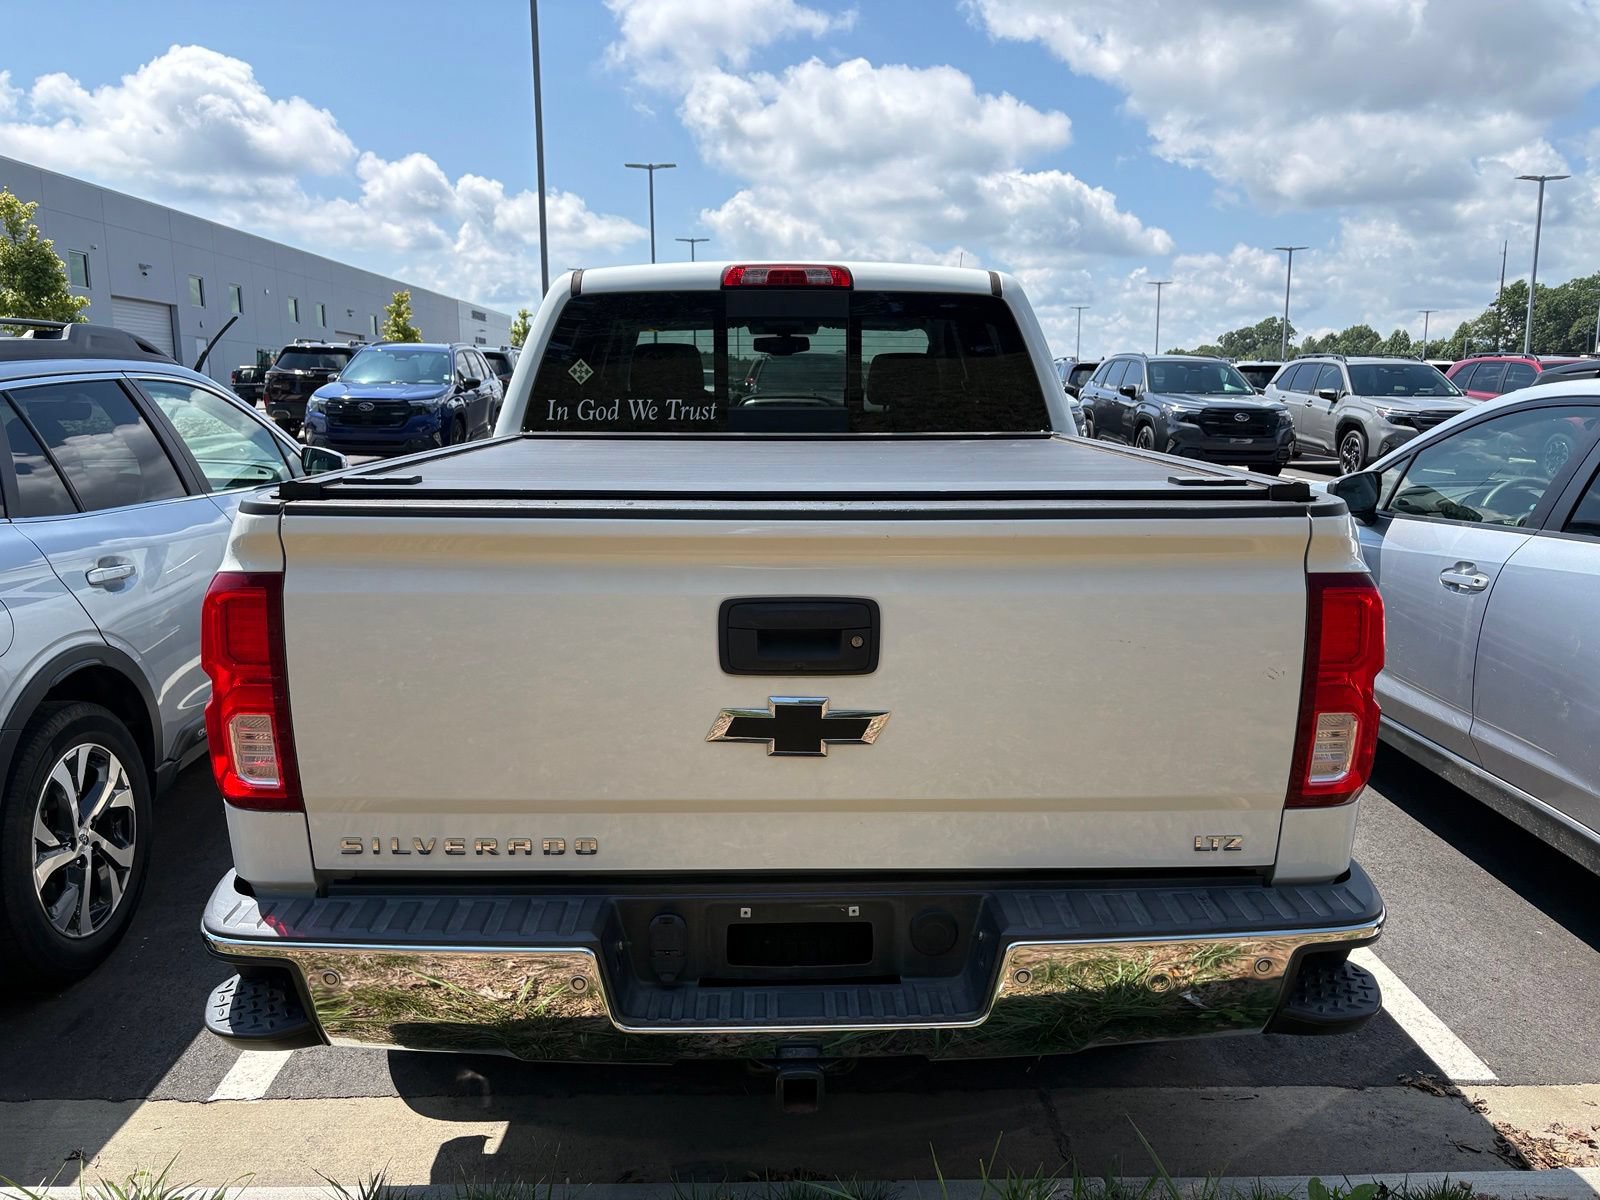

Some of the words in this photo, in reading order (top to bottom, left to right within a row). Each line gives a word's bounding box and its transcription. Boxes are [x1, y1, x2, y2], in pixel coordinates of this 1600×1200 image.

[546, 399, 569, 421] In
[577, 399, 620, 421] God
[628, 399, 658, 421] We
[665, 399, 718, 421] Trust
[340, 837, 599, 856] SILVERADO
[1194, 834, 1243, 852] LTZ
